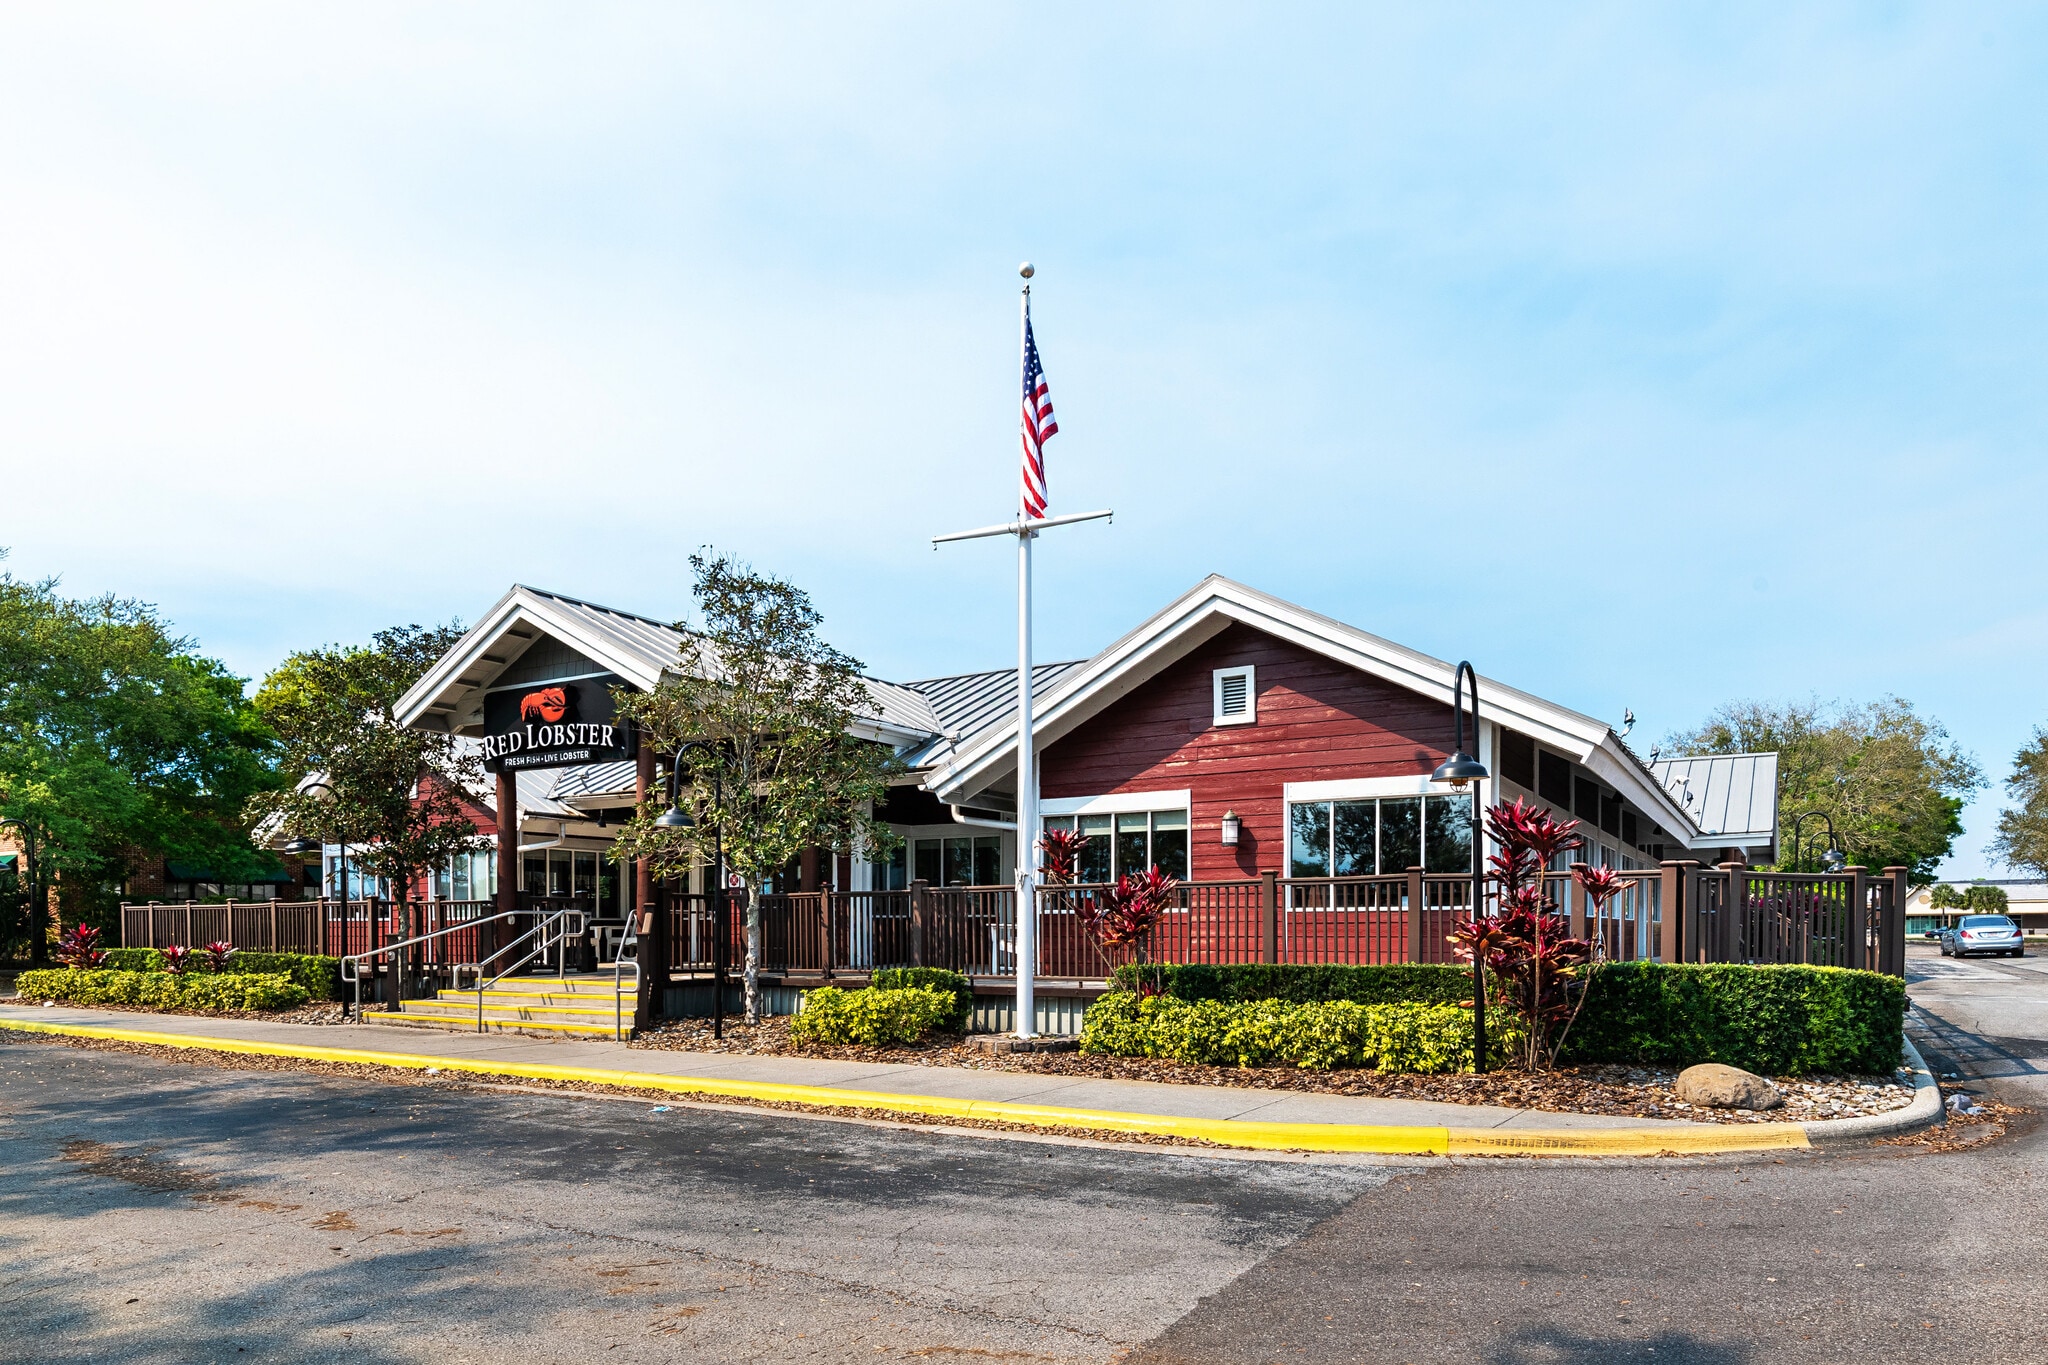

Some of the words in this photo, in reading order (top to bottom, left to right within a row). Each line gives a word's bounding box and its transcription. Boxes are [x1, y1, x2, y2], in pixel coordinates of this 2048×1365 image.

[482, 731, 522, 761] RED
[526, 723, 614, 749] LOBSTER
[505, 756, 525, 767] FRESH
[560, 750, 589, 761] LOBSTER
